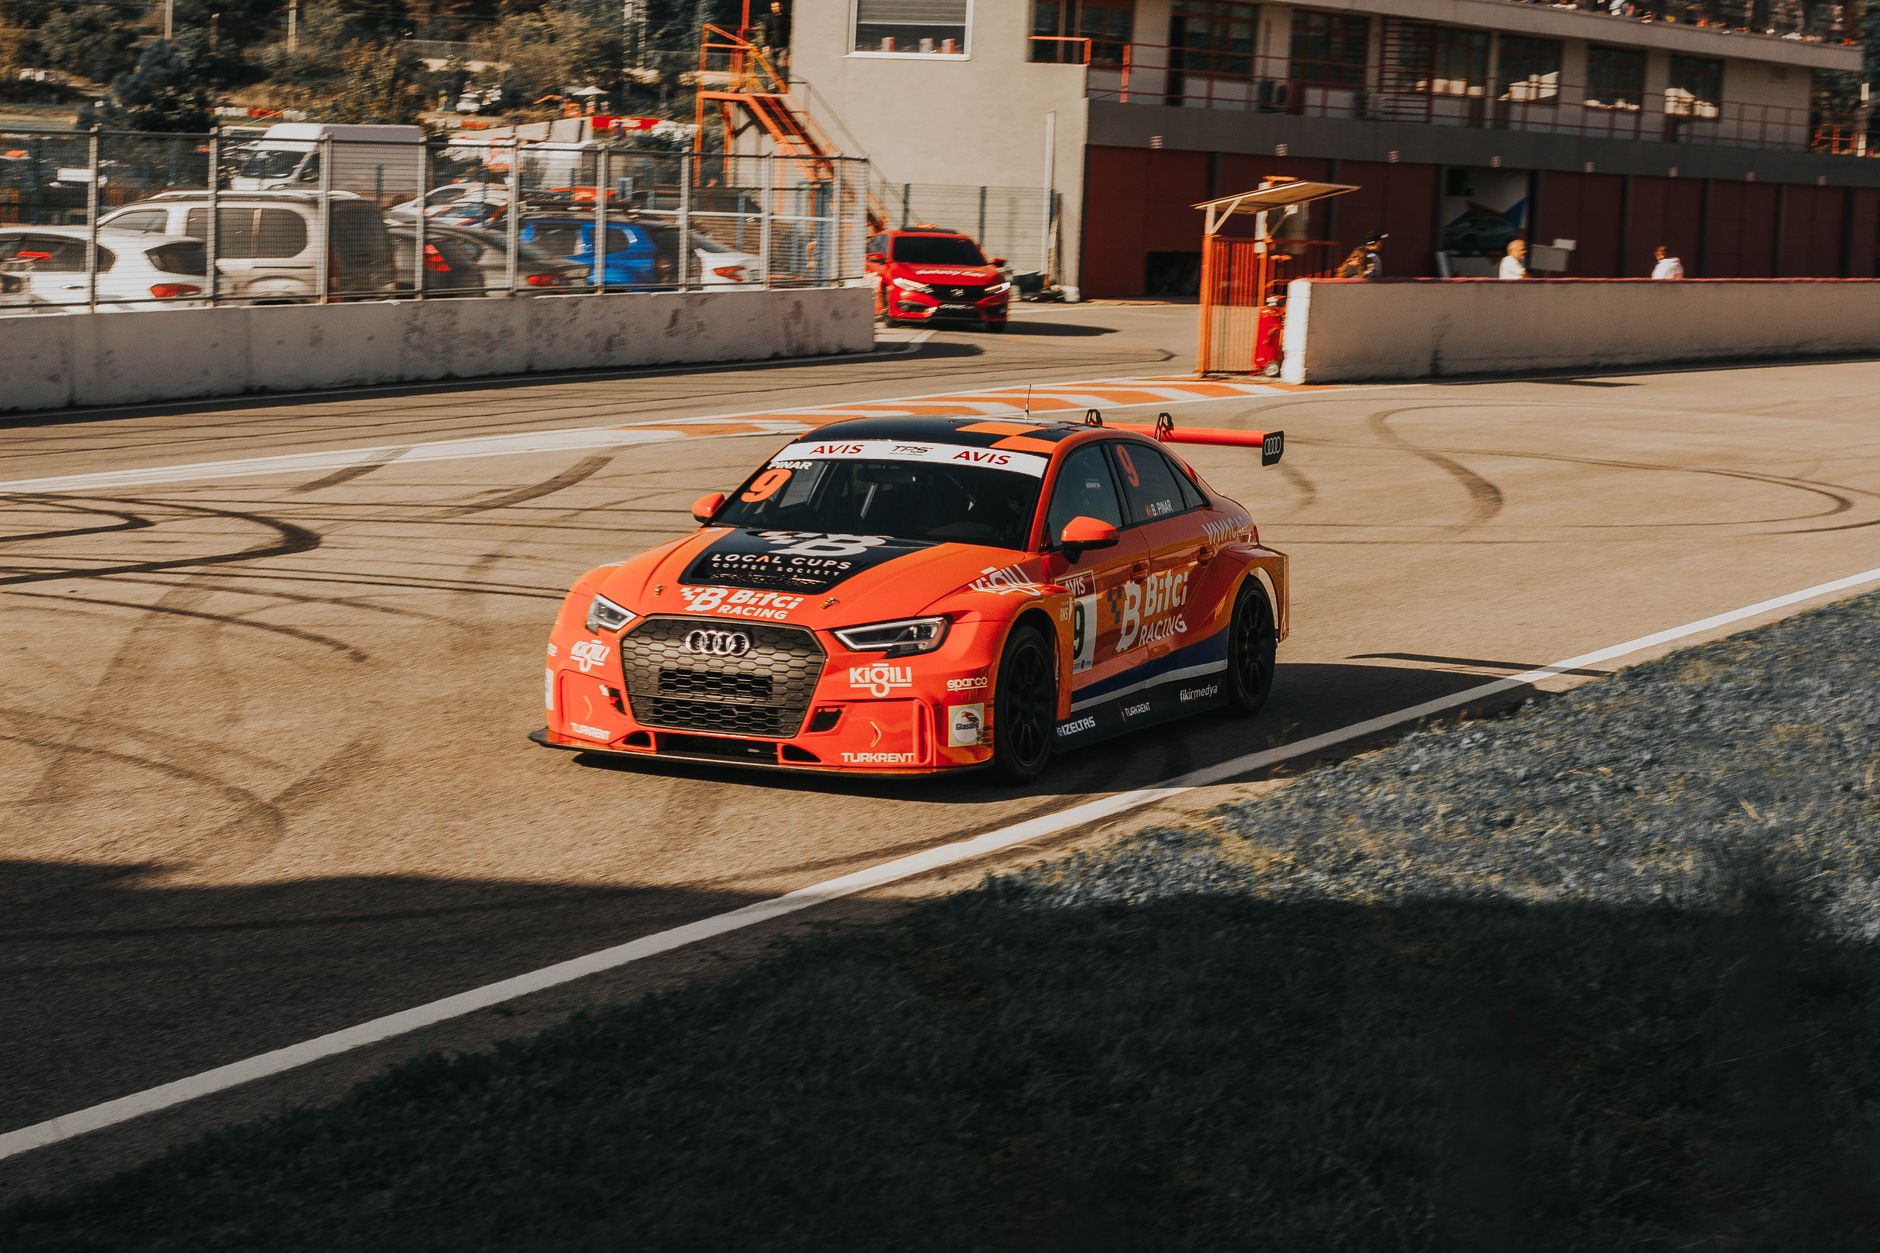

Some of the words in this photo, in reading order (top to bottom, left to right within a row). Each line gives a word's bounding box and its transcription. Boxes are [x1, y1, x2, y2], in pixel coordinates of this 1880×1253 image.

[809, 444, 865, 455] AVIS
[767, 461, 813, 470] PINAR
[952, 450, 1012, 466] AVIS
[1116, 445, 1140, 487] 9
[740, 468, 793, 503] 9
[711, 553, 782, 564] LOCAL
[791, 557, 852, 570] CUPS
[712, 562, 767, 571] COFFEE
[776, 566, 841, 577] SOCIETY
[717, 604, 789, 620] RACING
[1139, 613, 1187, 647] RACING
[946, 676, 988, 691] sparco
[1179, 684, 1219, 702] fikirmedya
[1124, 702, 1151, 717] TURKRENT
[841, 752, 915, 763] TURKRENT
